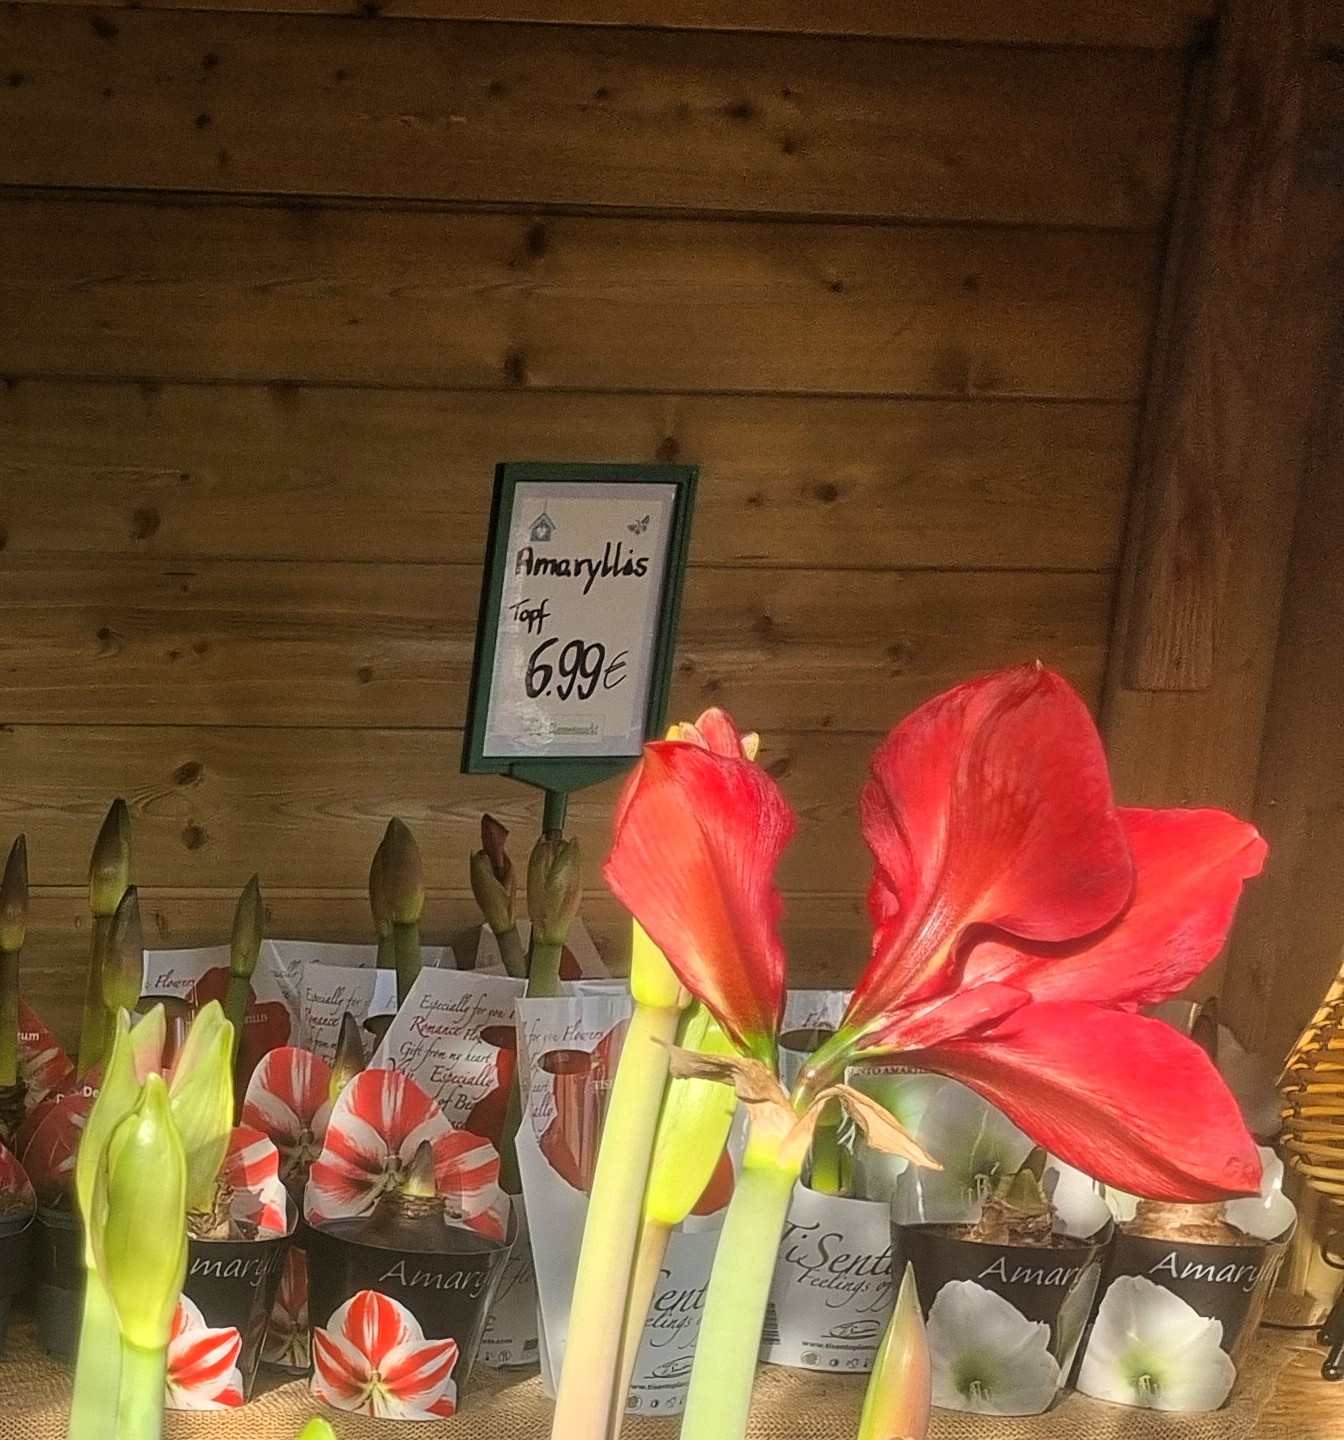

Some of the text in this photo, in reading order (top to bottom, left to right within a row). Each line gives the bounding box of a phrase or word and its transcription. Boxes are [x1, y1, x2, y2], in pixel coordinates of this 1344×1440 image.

[514, 541, 650, 595] Amaryllis
[509, 598, 551, 634] Topf
[409, 1015, 463, 1038] Romance
[430, 1063, 498, 1100] Especially
[797, 1267, 869, 1309] Feelings
